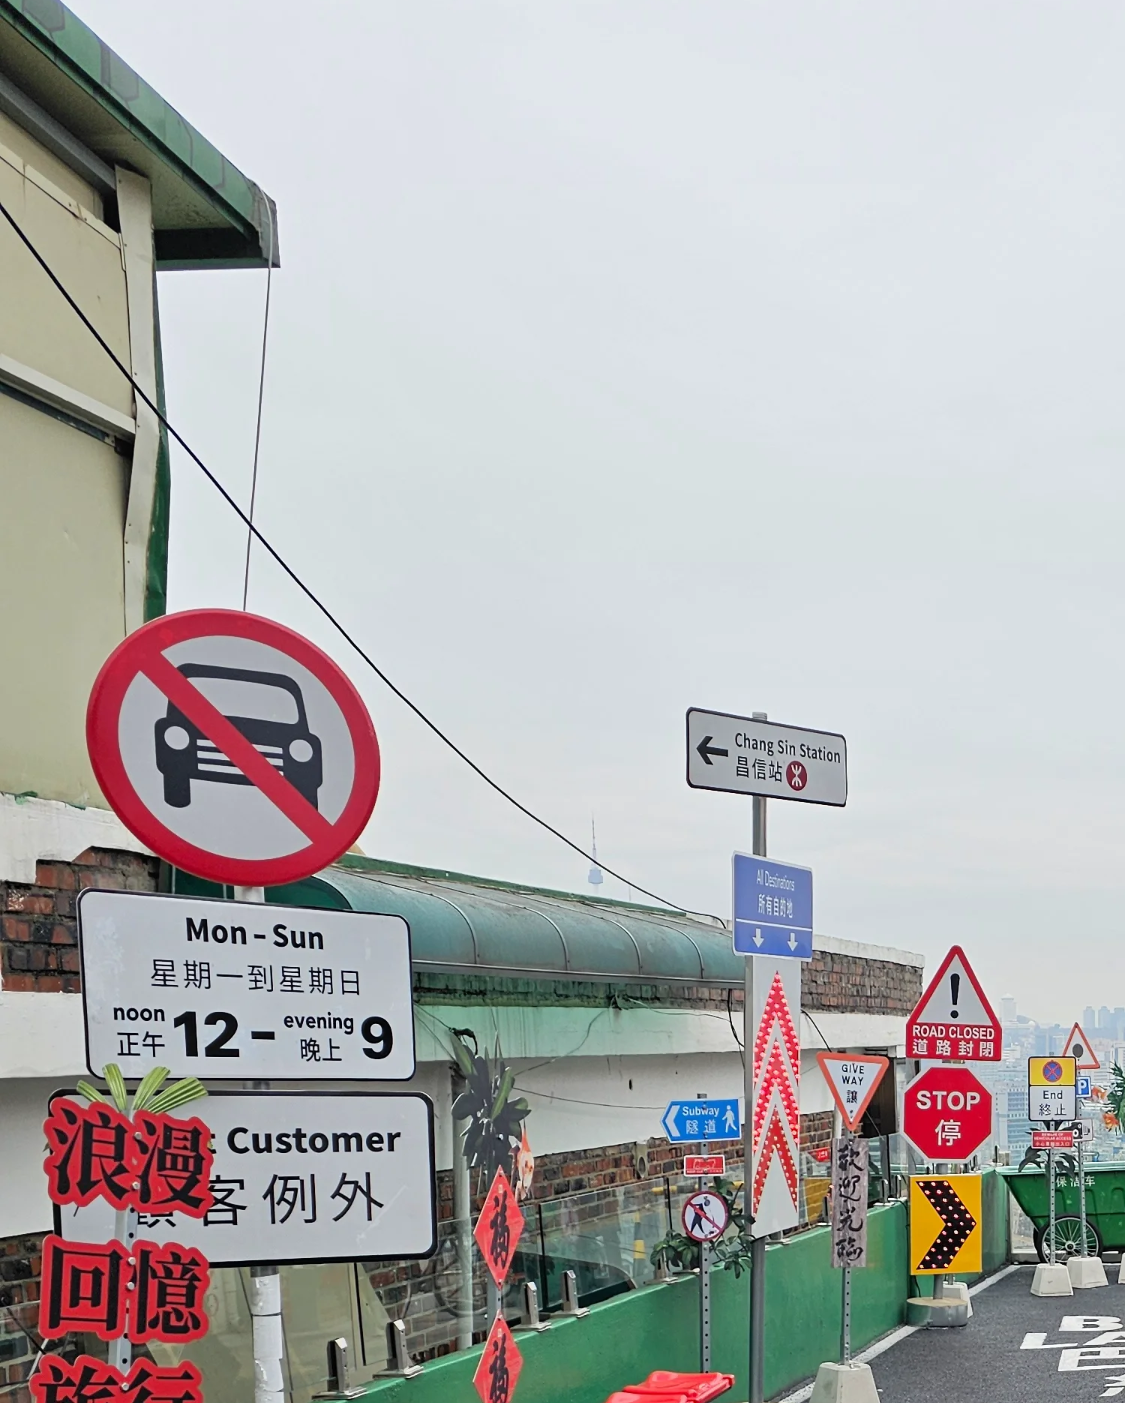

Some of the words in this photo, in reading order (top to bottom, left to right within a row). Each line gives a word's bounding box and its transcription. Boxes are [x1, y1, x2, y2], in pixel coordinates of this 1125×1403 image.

[735, 733, 774, 756] Chang
[778, 740, 796, 756] Sin
[799, 744, 841, 763] Station
[736, 757, 783, 782] 昌信站
[186, 917, 246, 945] Mon
[273, 924, 324, 950] Sun
[151, 959, 360, 996] 星期一到星期日
[113, 1005, 165, 1022] noon
[173, 1011, 240, 1058] 12
[283, 1012, 354, 1035] evening
[361, 1016, 394, 1060] 9
[912, 1025, 946, 1038] ROAD
[949, 1025, 995, 1040] CLOSED
[117, 1031, 165, 1058] 正午
[300, 1038, 342, 1062] 晚上
[912, 1038, 994, 1058] 道路封閉
[841, 1063, 865, 1074] GIVE
[841, 1075, 864, 1086] WAY
[916, 1090, 981, 1111] STOP
[1043, 1090, 1063, 1100] End
[682, 1106, 719, 1117] Subway
[1039, 1103, 1067, 1116] 終止
[227, 1126, 402, 1153] Customer
[935, 1119, 962, 1147] 停
[53, 1107, 206, 1208] 浪漫
[48, 1244, 202, 1335] 回憶
